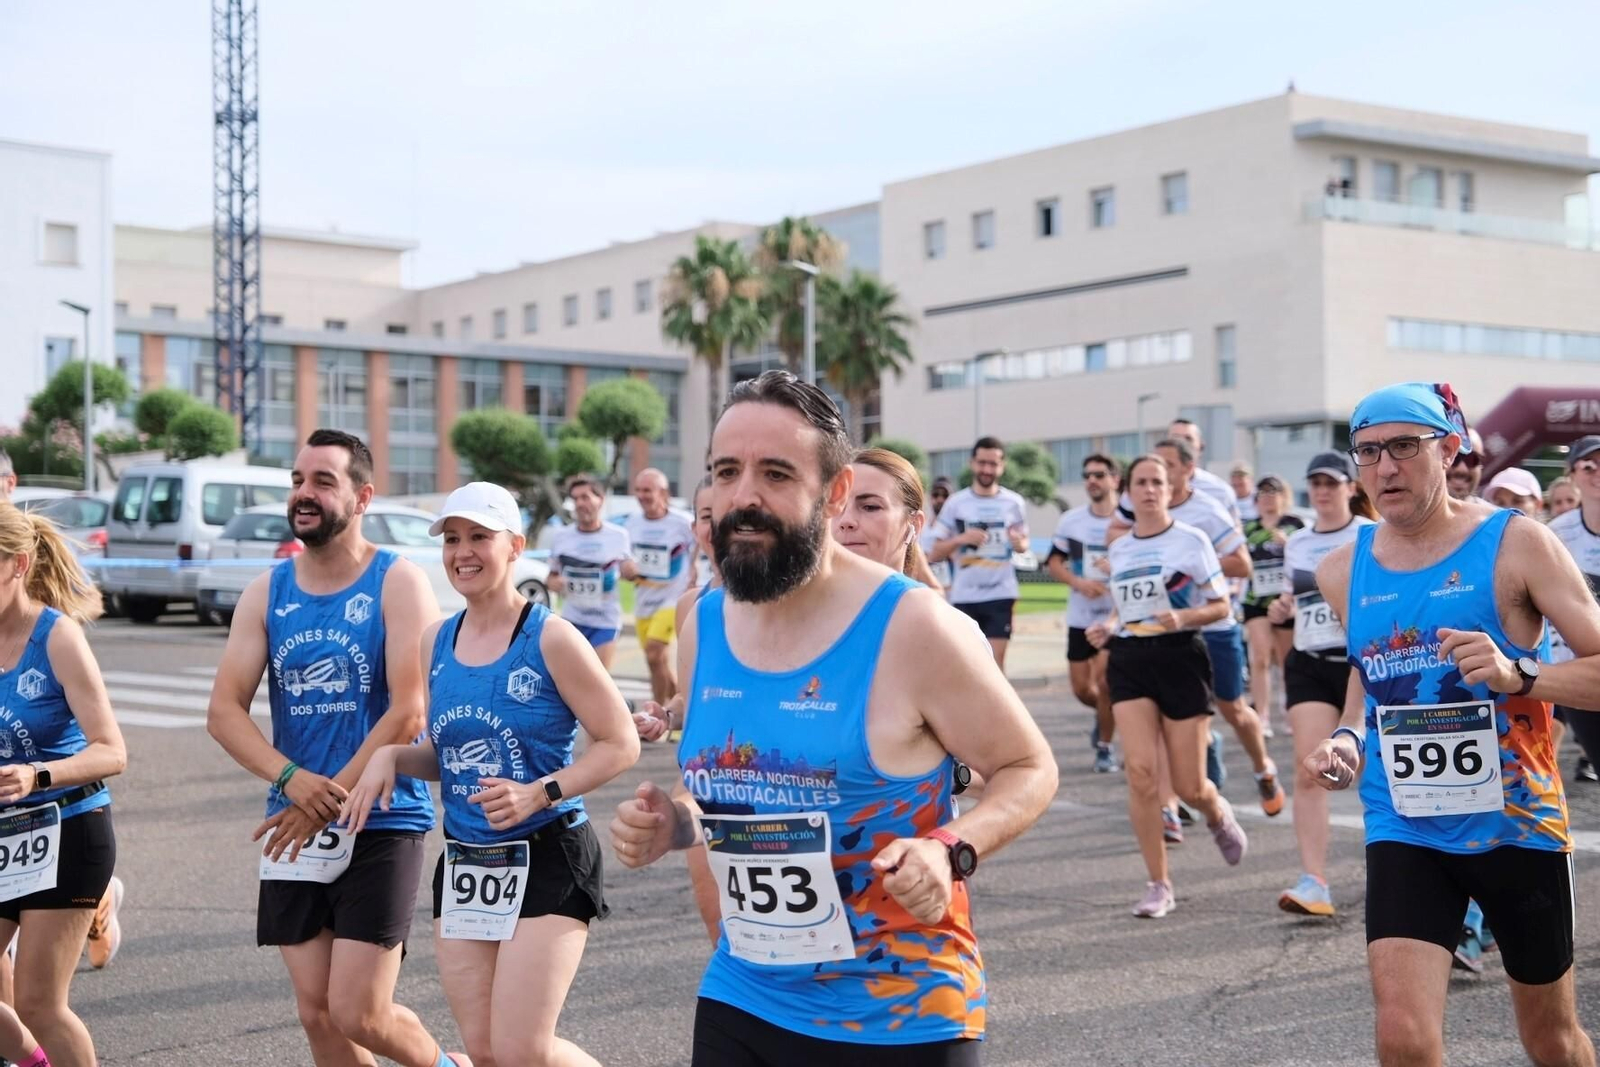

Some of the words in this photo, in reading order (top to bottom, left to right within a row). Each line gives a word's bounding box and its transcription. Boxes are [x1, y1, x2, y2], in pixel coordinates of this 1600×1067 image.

[1117, 581, 1158, 602] 762
[1429, 585, 1475, 597] TROTACALLES
[326, 629, 350, 647] SAN
[347, 643, 371, 694] ROQUE
[1362, 653, 1388, 683] 20
[1385, 646, 1427, 661] CARRERA
[1387, 653, 1456, 679] TROTACAL
[290, 705, 313, 716] DOS
[315, 701, 357, 714] TORRES
[779, 700, 838, 712] TROTACALLES
[1427, 710, 1462, 718] CARRERA
[1406, 717, 1420, 725] POR
[1428, 714, 1484, 725] INVESTIGACIÓ
[475, 706, 503, 730] SAN
[500, 727, 524, 780] ROQUE
[1393, 739, 1483, 779] 596
[684, 768, 712, 801] 20
[710, 768, 764, 783] CARRERA
[766, 772, 838, 790] NOCTURNA
[712, 783, 841, 807] TROTACALLES
[750, 824, 788, 833] CARRERA
[752, 830, 816, 842] INVESTIGACIÓN
[455, 872, 518, 906] 904
[727, 865, 818, 914] 453
